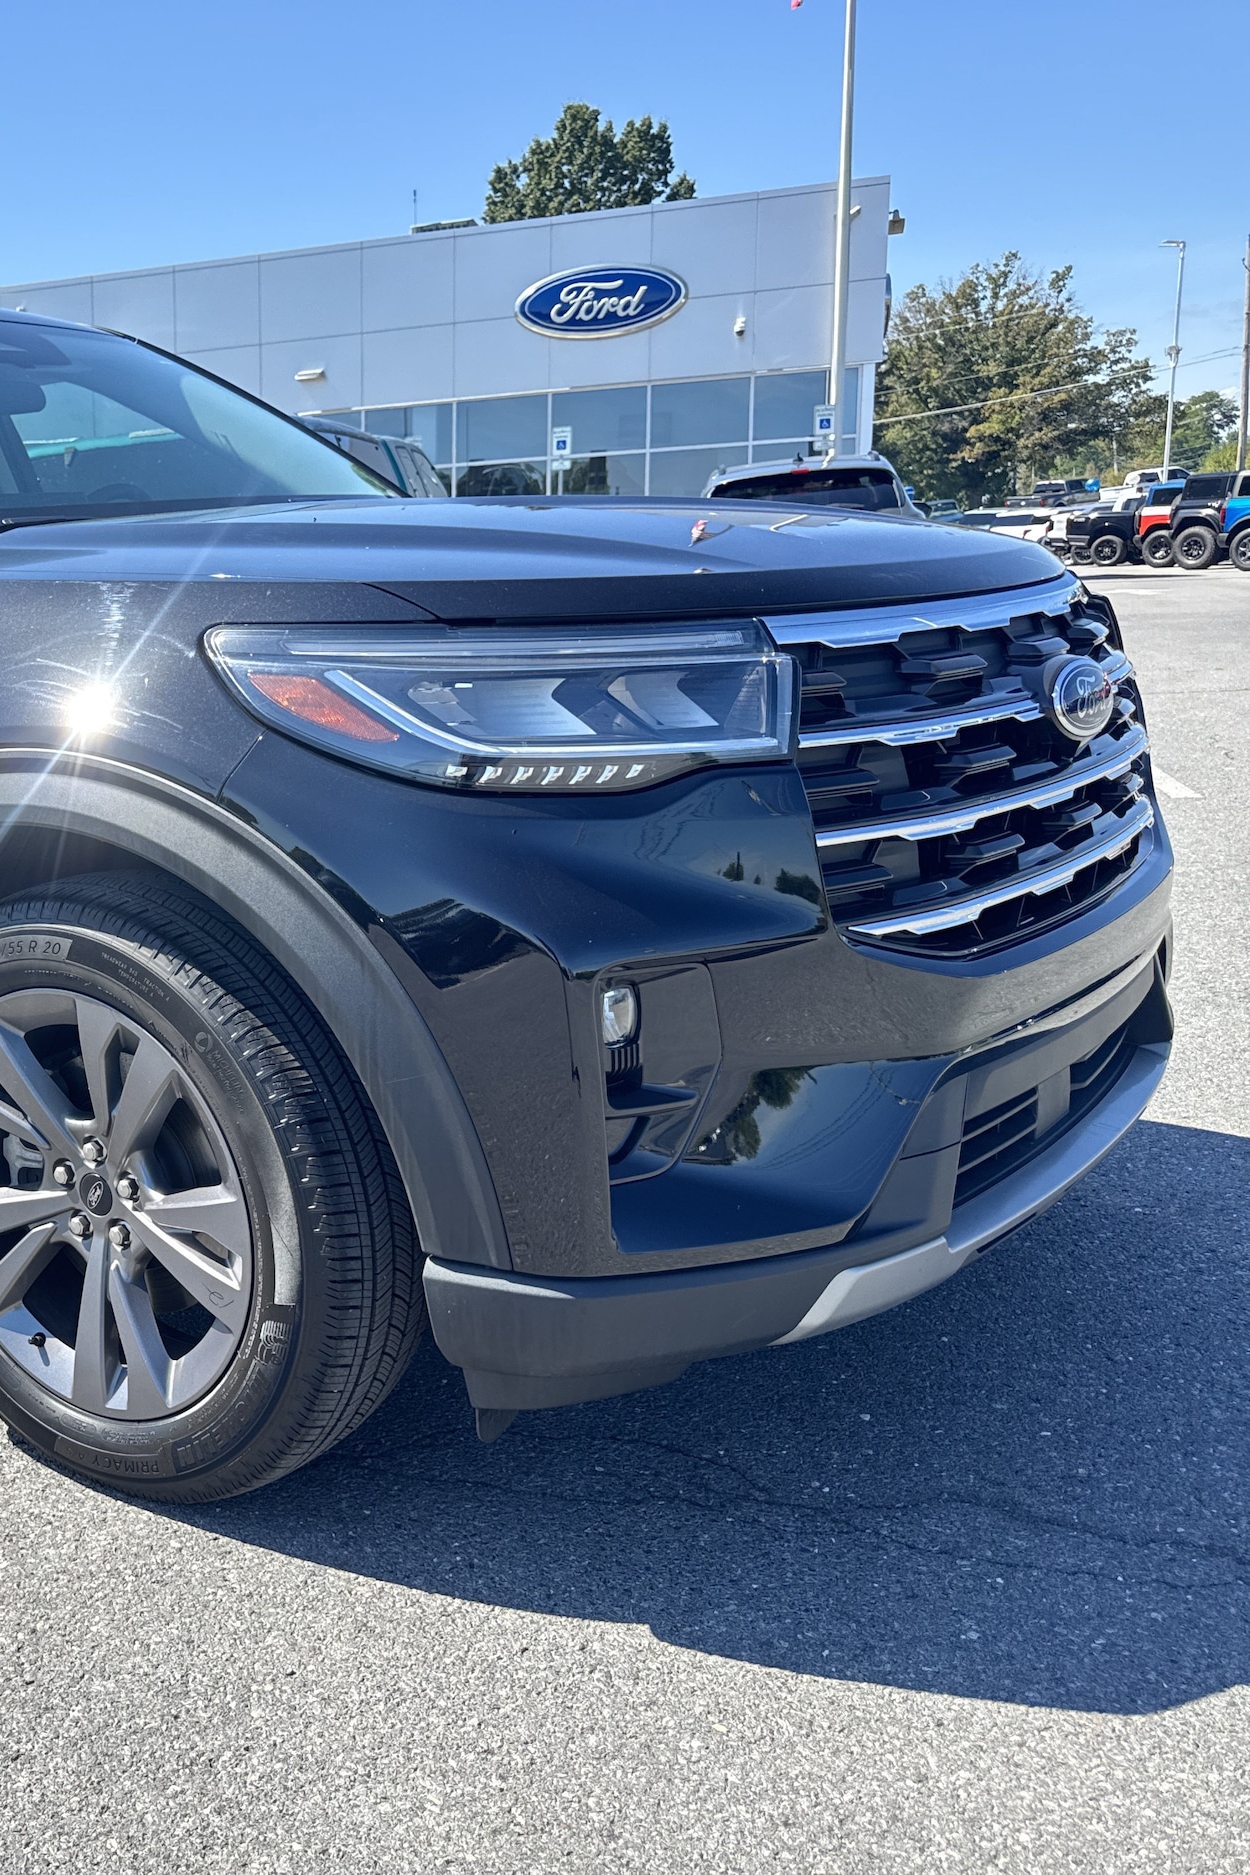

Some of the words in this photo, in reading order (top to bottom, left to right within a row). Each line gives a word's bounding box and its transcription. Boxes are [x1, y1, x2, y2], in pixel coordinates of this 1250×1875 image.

[550, 279, 648, 323] Ford
[1076, 675, 1111, 718] Ford
[28, 940, 38, 953] R
[42, 941, 62, 955] 20
[211, 1050, 244, 1094] MICHELIN
[91, 1457, 159, 1474] PRIMACY
